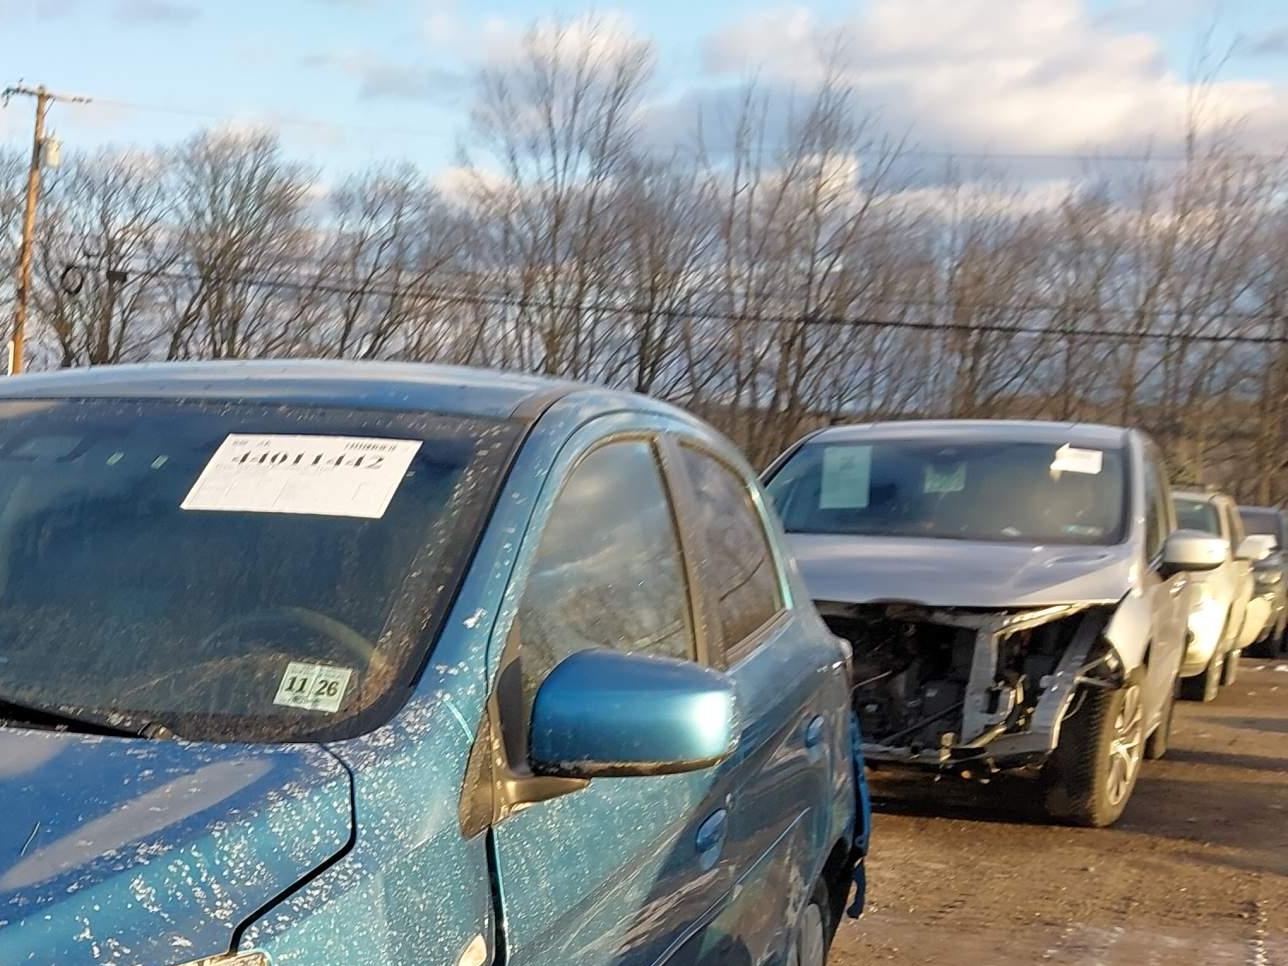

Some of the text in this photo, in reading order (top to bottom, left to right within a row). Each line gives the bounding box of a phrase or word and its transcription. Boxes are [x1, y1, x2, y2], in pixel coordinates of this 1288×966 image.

[231, 449, 385, 469] 44011442
[284, 675, 339, 697] 11 26
